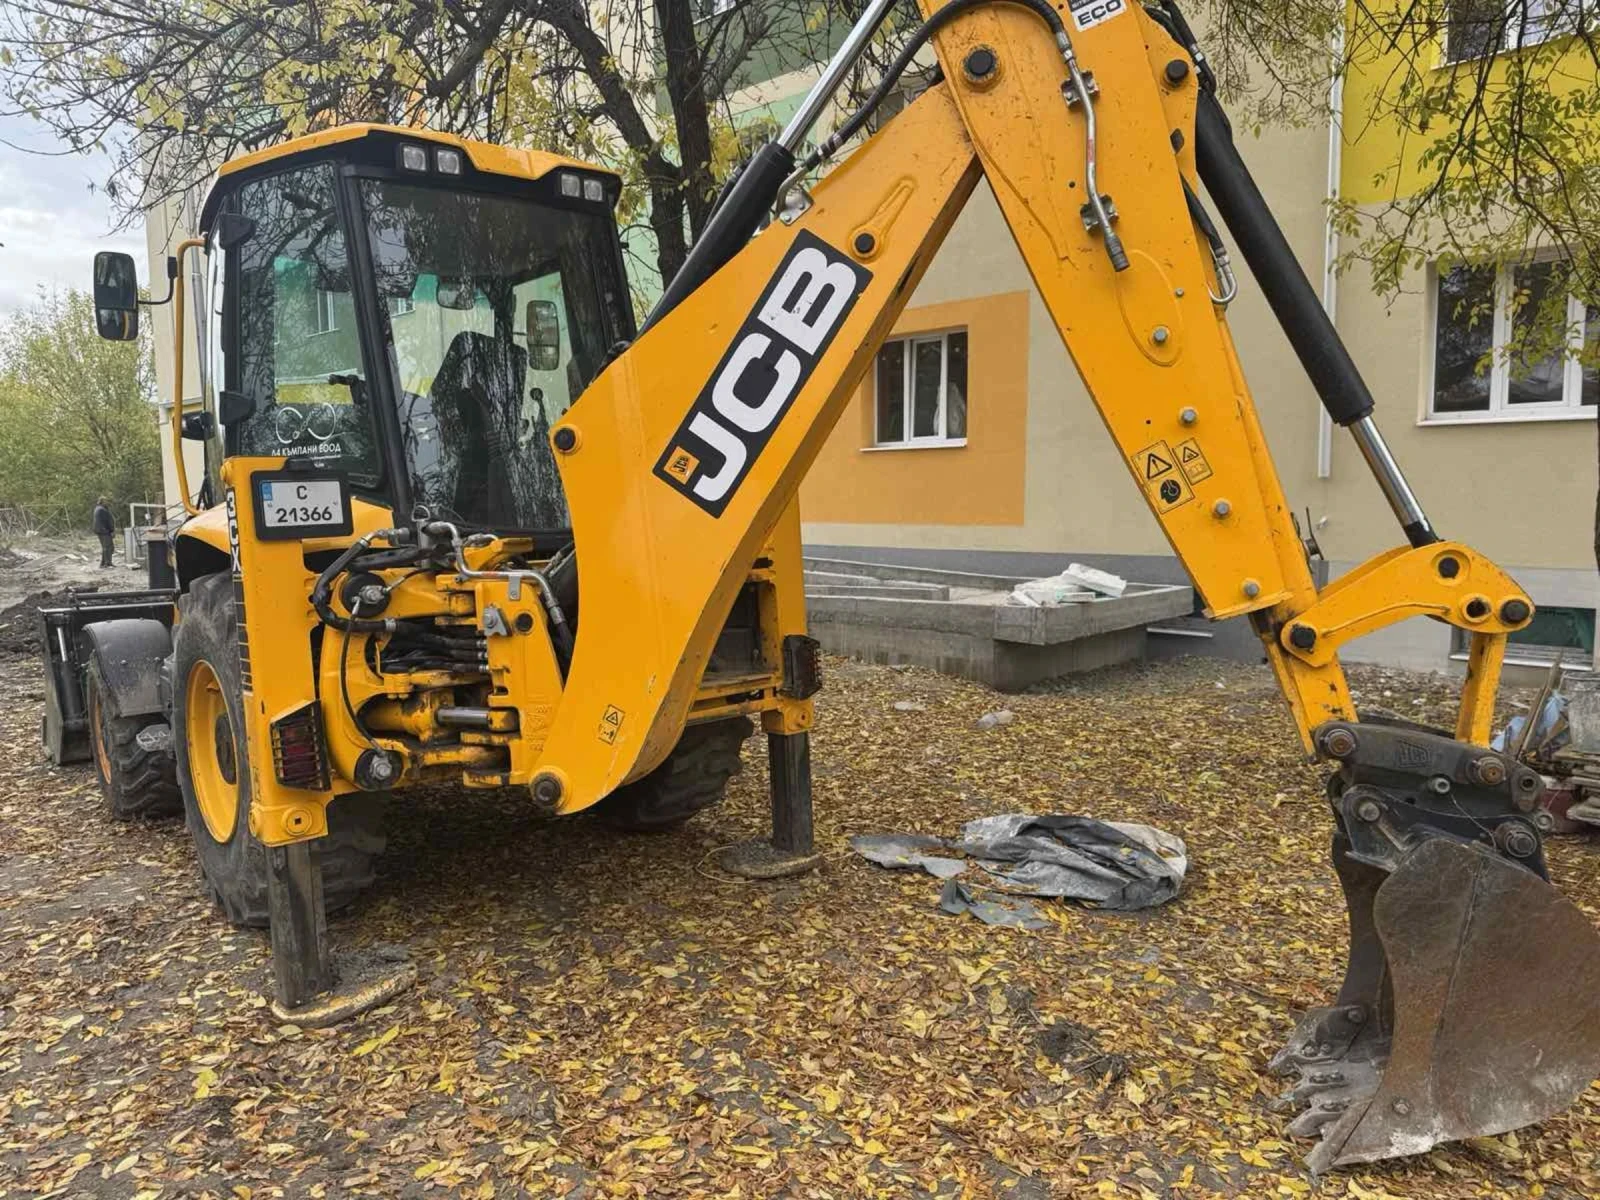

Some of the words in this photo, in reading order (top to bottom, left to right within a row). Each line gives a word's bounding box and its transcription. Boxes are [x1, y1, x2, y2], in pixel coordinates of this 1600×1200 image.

[1078, 0, 1121, 25] ECO
[688, 247, 856, 501] JCB
[319, 443, 342, 453] ЕООД
[673, 456, 689, 473] JCB
[296, 485, 308, 500] C
[275, 506, 333, 523] 21366
[227, 490, 241, 572] 3CX
